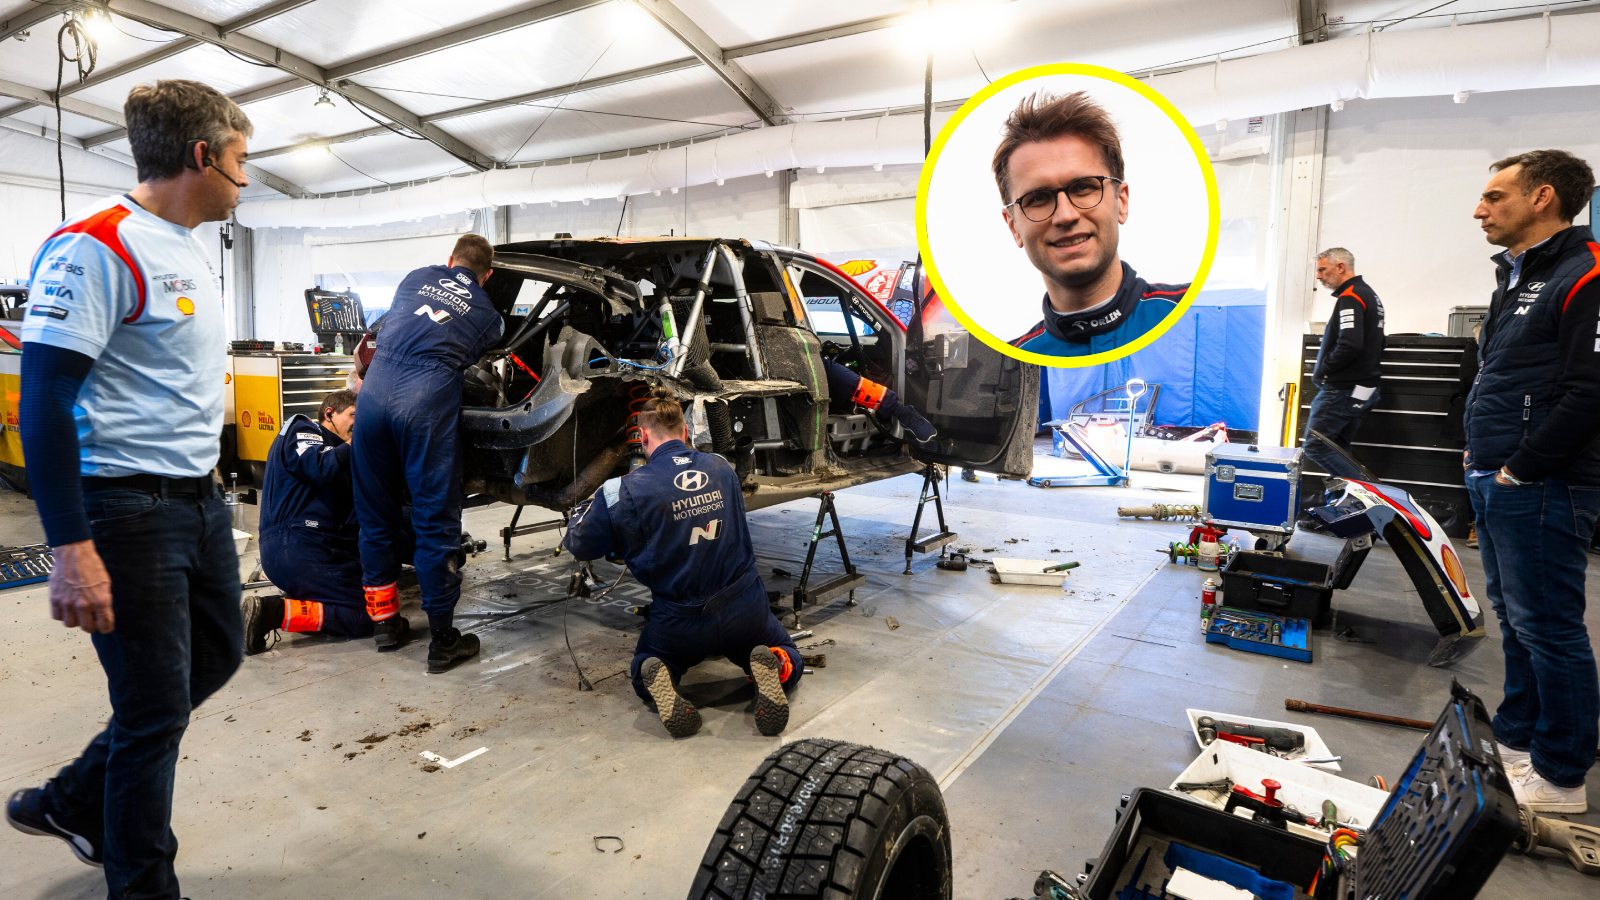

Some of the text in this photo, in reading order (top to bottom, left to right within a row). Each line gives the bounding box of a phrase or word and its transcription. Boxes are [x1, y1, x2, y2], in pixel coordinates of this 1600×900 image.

[163, 279, 196, 293] MOBIS
[456, 273, 472, 287] OMP
[417, 290, 467, 316] MOTORSPORT
[421, 284, 472, 312] HYUNDAI
[1090, 309, 1122, 327] ORLEN
[258, 414, 275, 425] HELIX
[671, 490, 722, 511] HYUNDAI
[673, 500, 724, 520] MOTORSPORT
